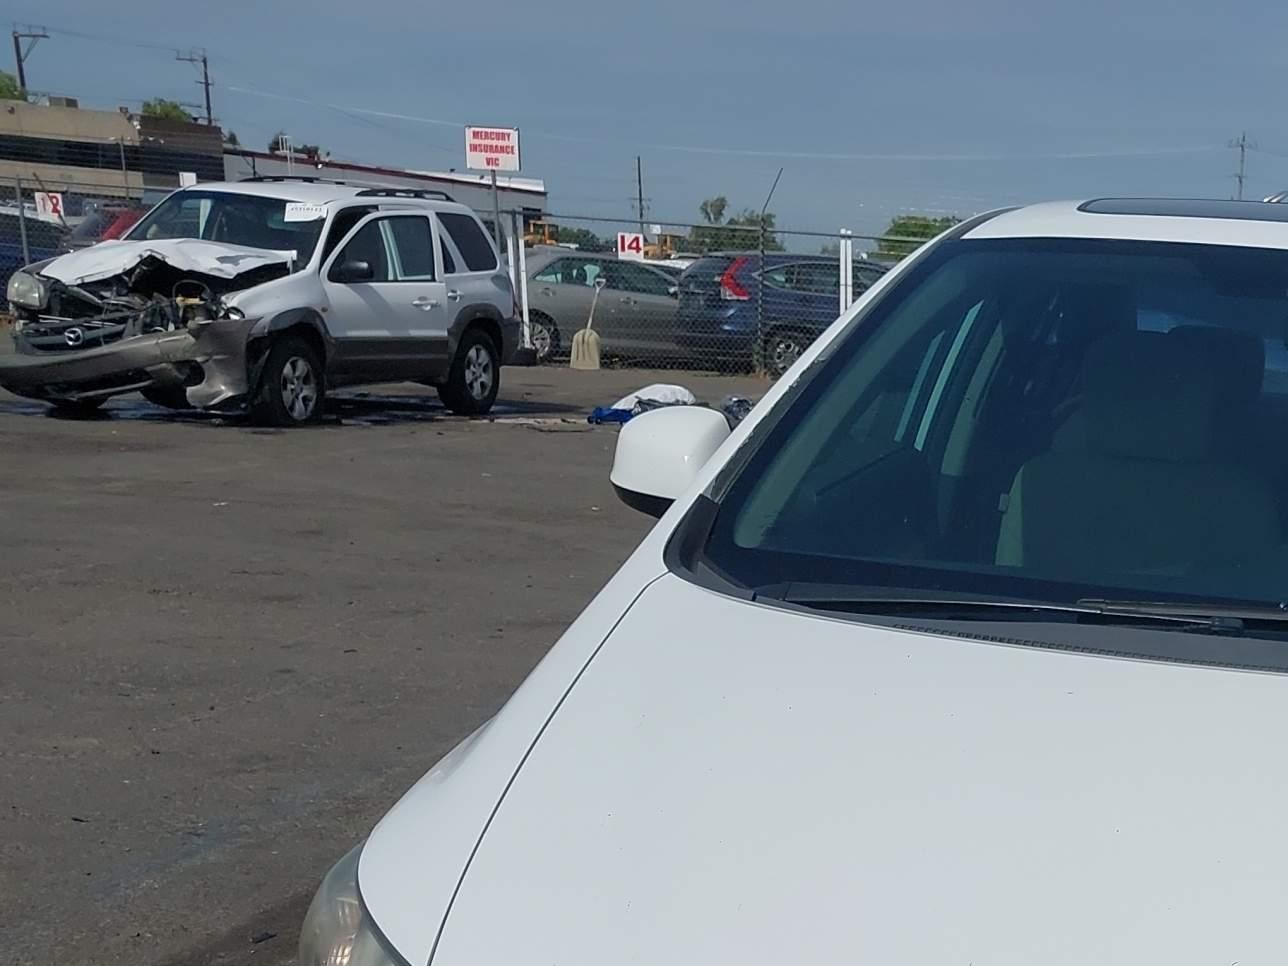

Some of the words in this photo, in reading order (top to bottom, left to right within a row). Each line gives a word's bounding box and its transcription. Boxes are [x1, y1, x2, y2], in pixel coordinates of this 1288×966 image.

[472, 130, 511, 142] MERCURY
[469, 143, 515, 155] INSURANCE
[485, 157, 500, 167] VIC
[620, 234, 642, 254] 14
